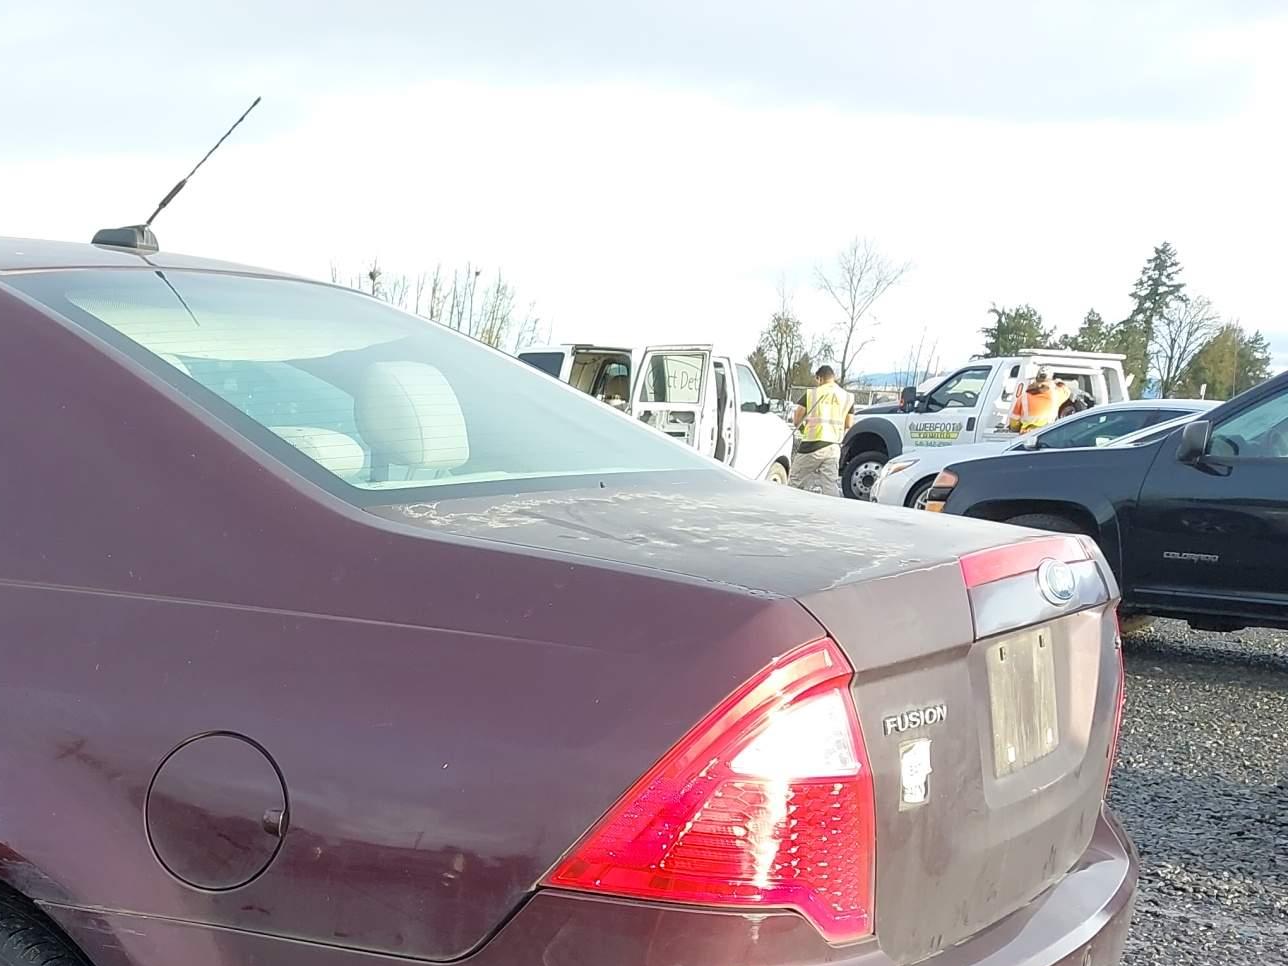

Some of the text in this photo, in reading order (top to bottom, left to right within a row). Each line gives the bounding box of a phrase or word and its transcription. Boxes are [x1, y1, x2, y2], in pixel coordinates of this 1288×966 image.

[915, 422, 956, 432] WEBFOOT
[1163, 551, 1219, 563] COLORADO
[883, 704, 947, 736] FUSION
